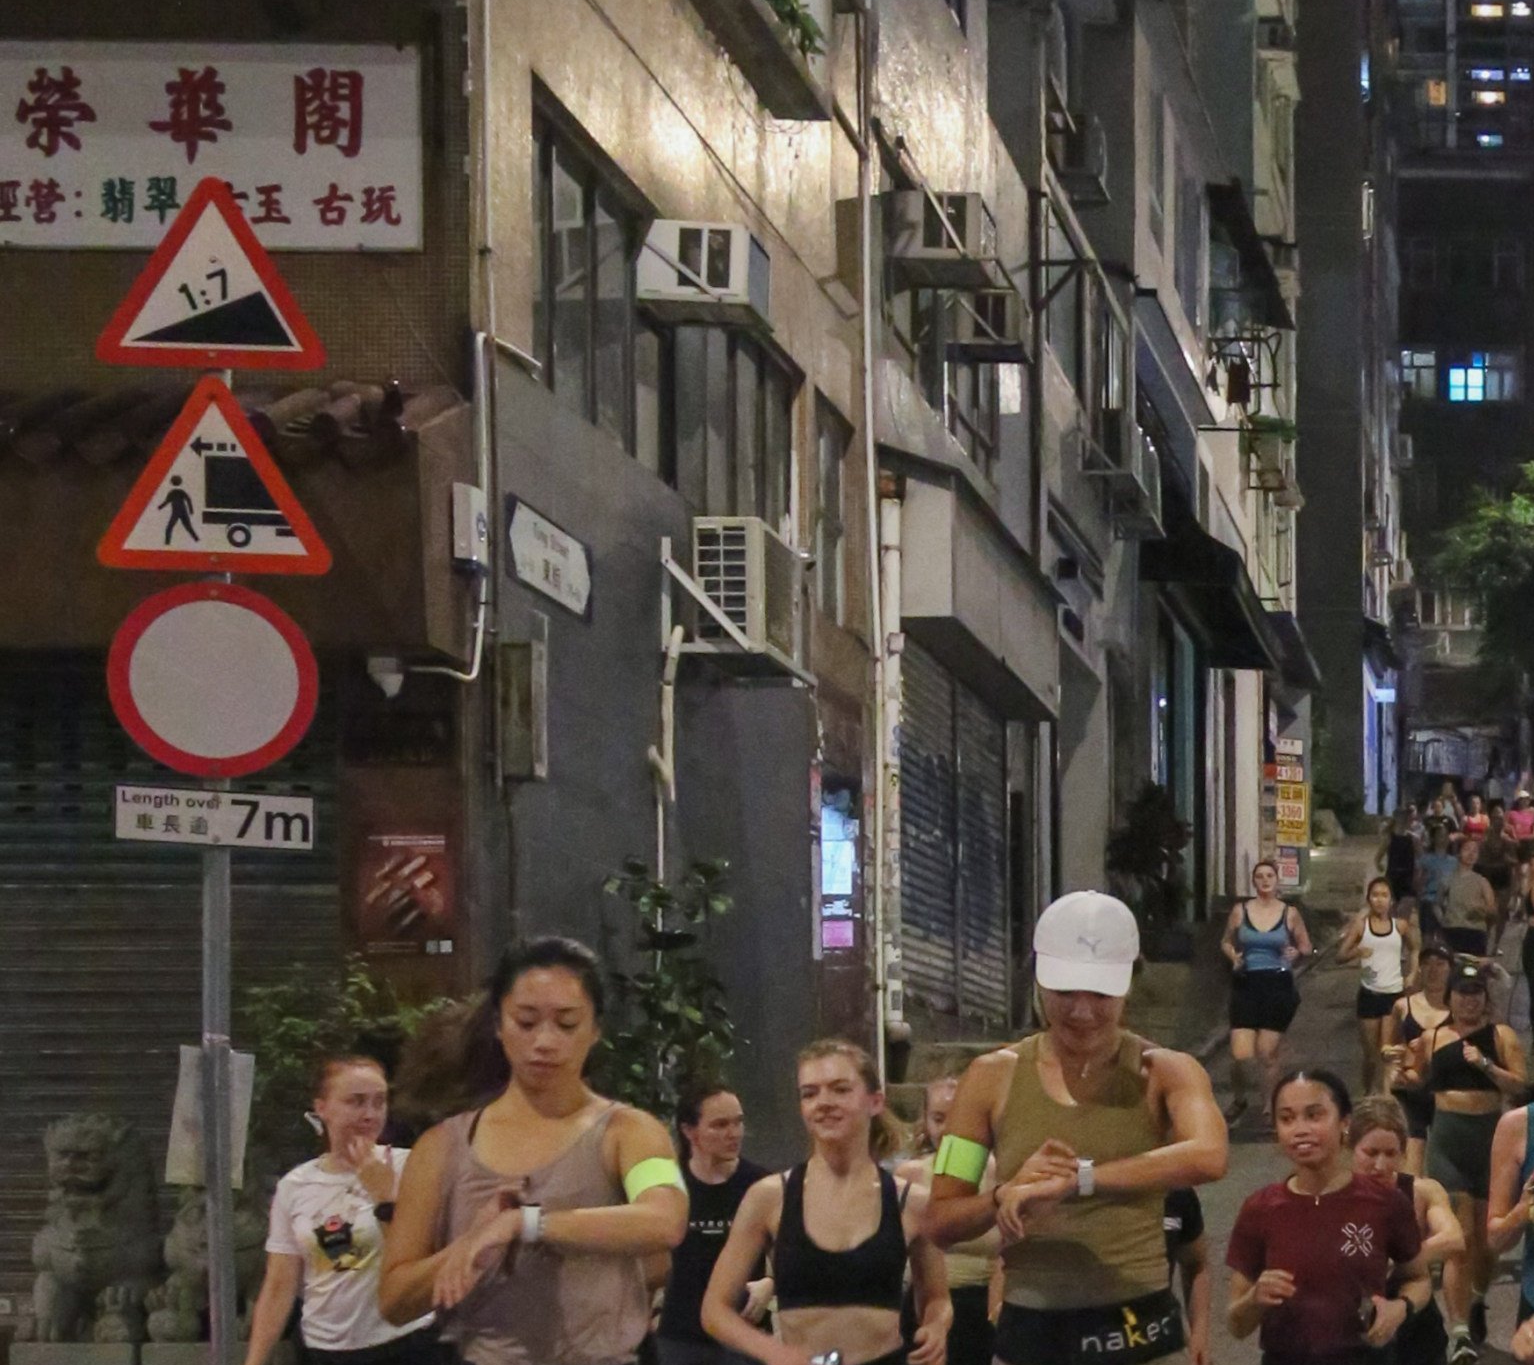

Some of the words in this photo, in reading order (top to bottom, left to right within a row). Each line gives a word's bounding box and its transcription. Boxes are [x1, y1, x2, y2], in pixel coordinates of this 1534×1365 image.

[15, 65, 364, 165] 榮華閣
[100, 175, 181, 225] 翡翠
[312, 181, 402, 226] 古玩
[178, 267, 229, 311] 1:7
[121, 789, 180, 810] Length
[185, 797, 221, 810] over
[230, 798, 310, 843] 7m
